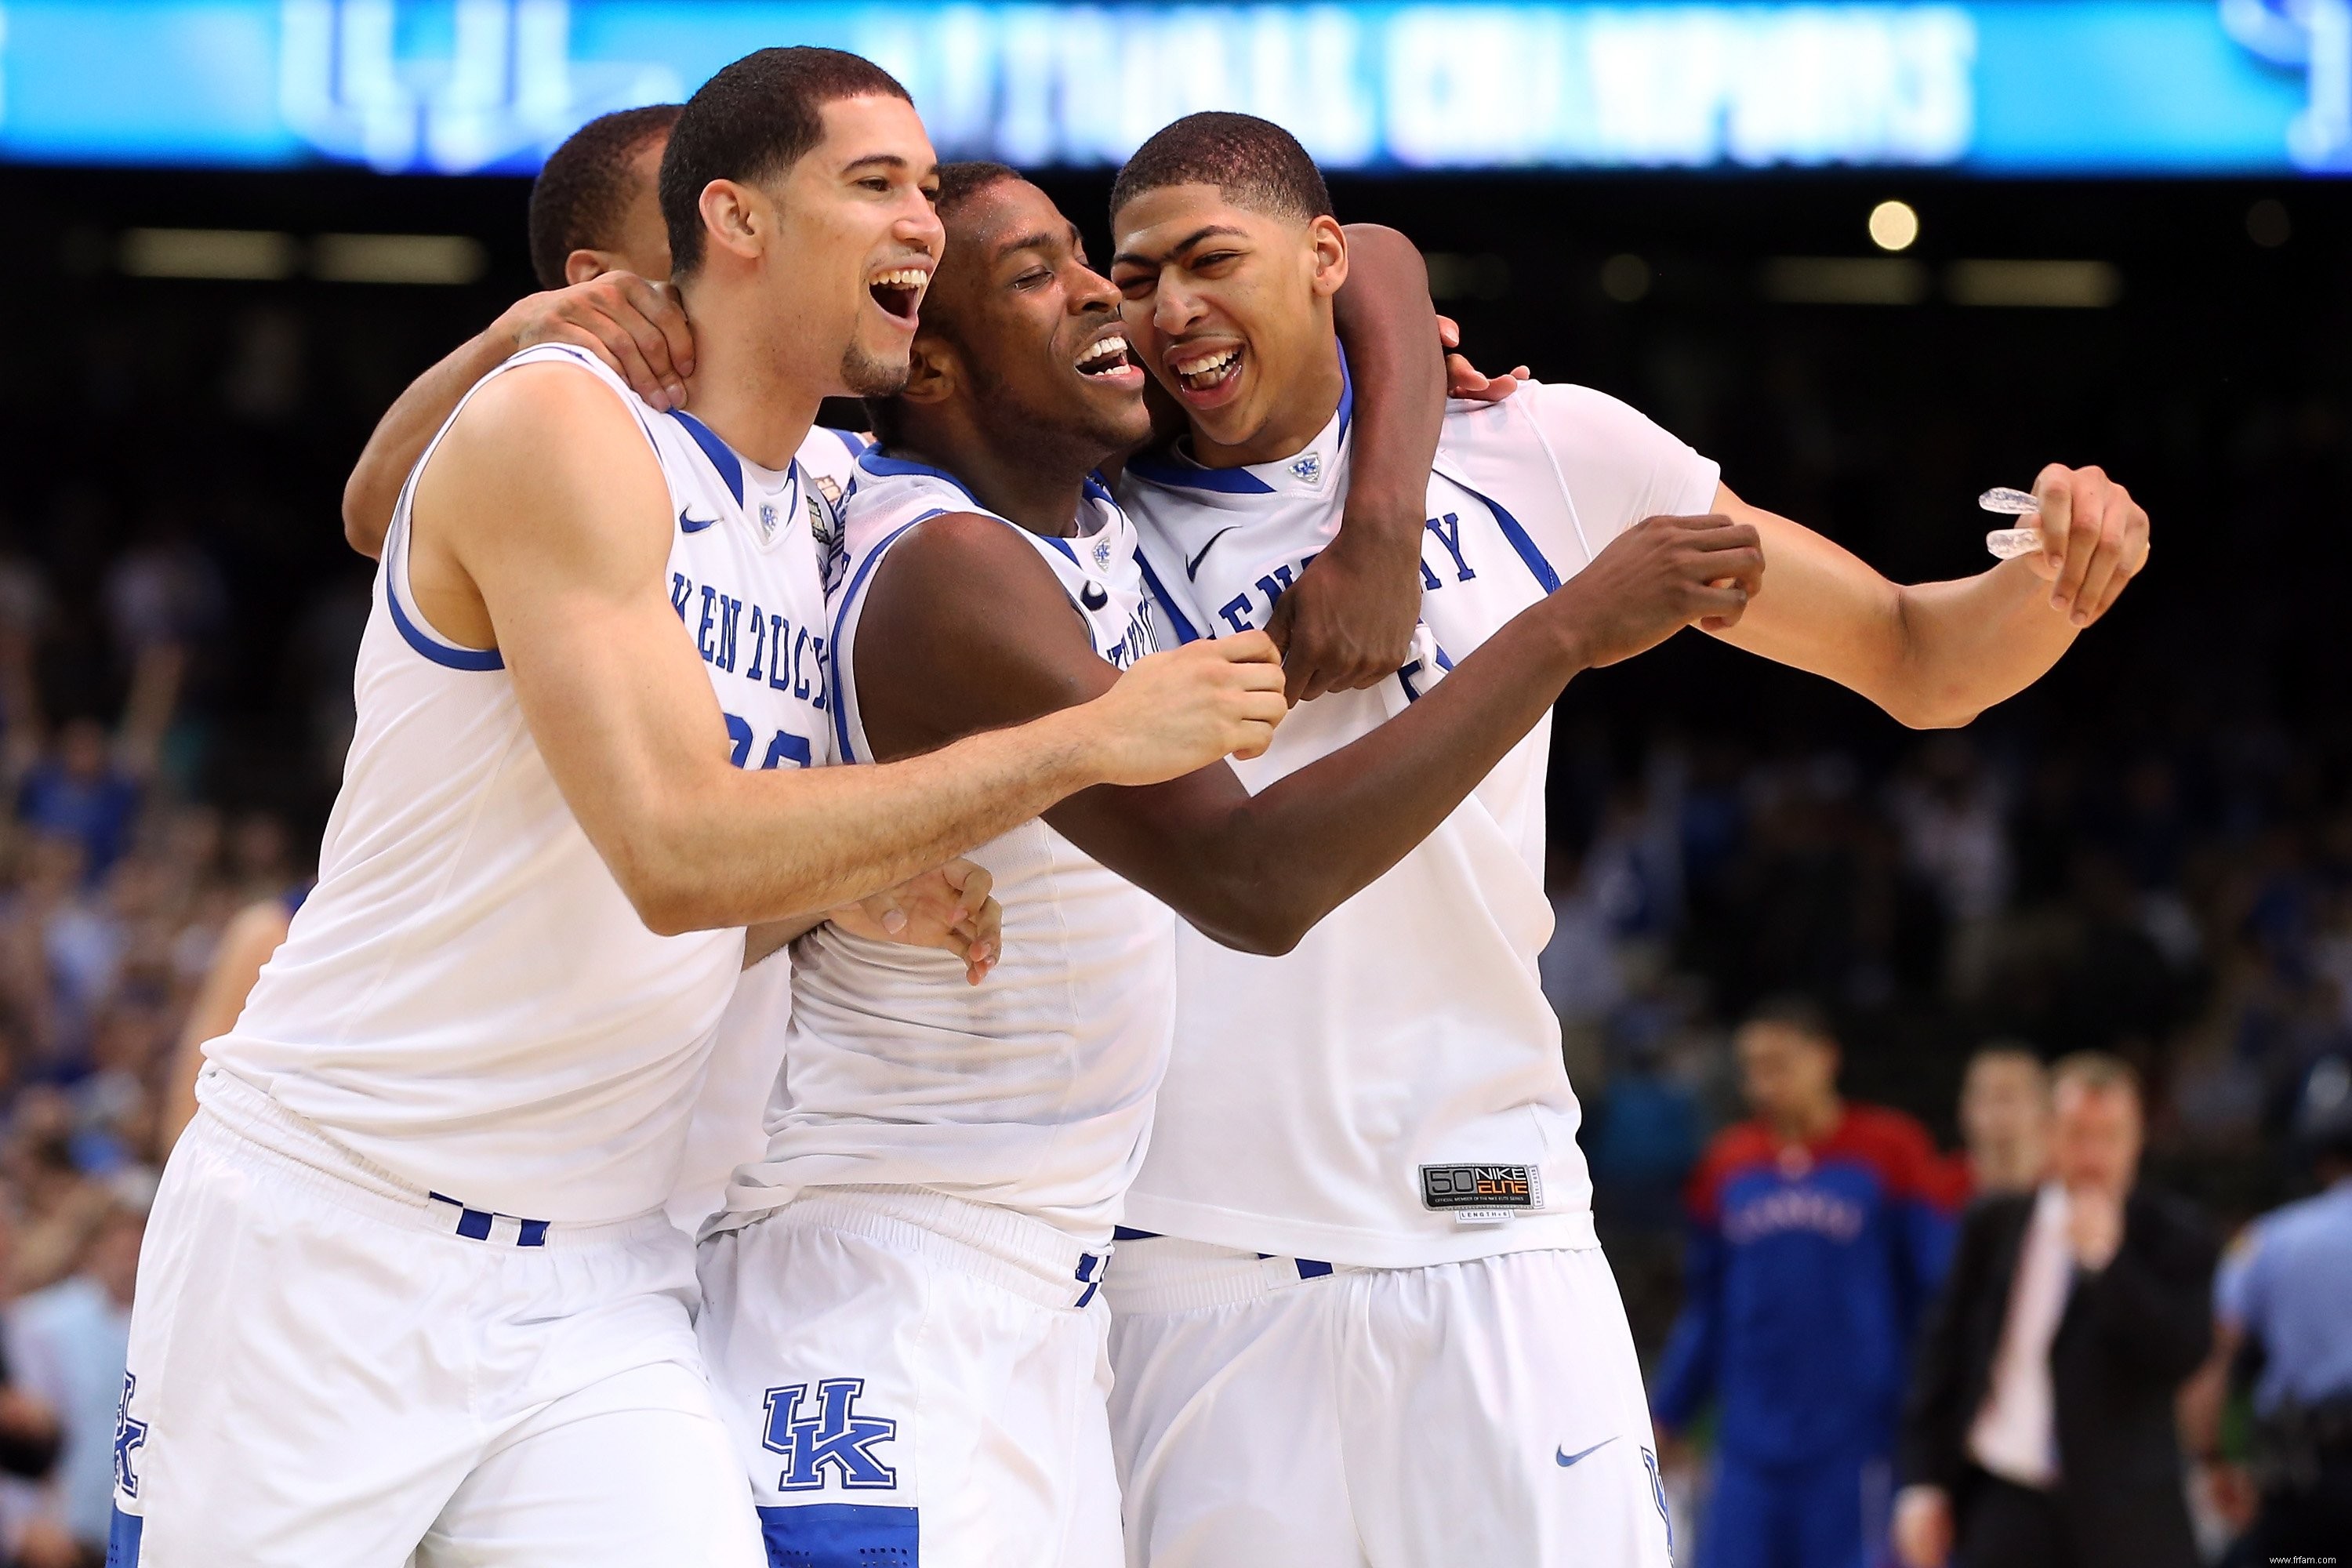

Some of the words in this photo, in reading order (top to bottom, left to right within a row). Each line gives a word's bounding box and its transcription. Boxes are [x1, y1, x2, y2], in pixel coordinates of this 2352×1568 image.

[671, 572, 829, 712] KENTUCK
[1429, 1169, 1475, 1194] 50
[1475, 1168, 1526, 1181] NIKE
[1477, 1181, 1528, 1194] ELITE
[762, 1377, 897, 1492] UK
